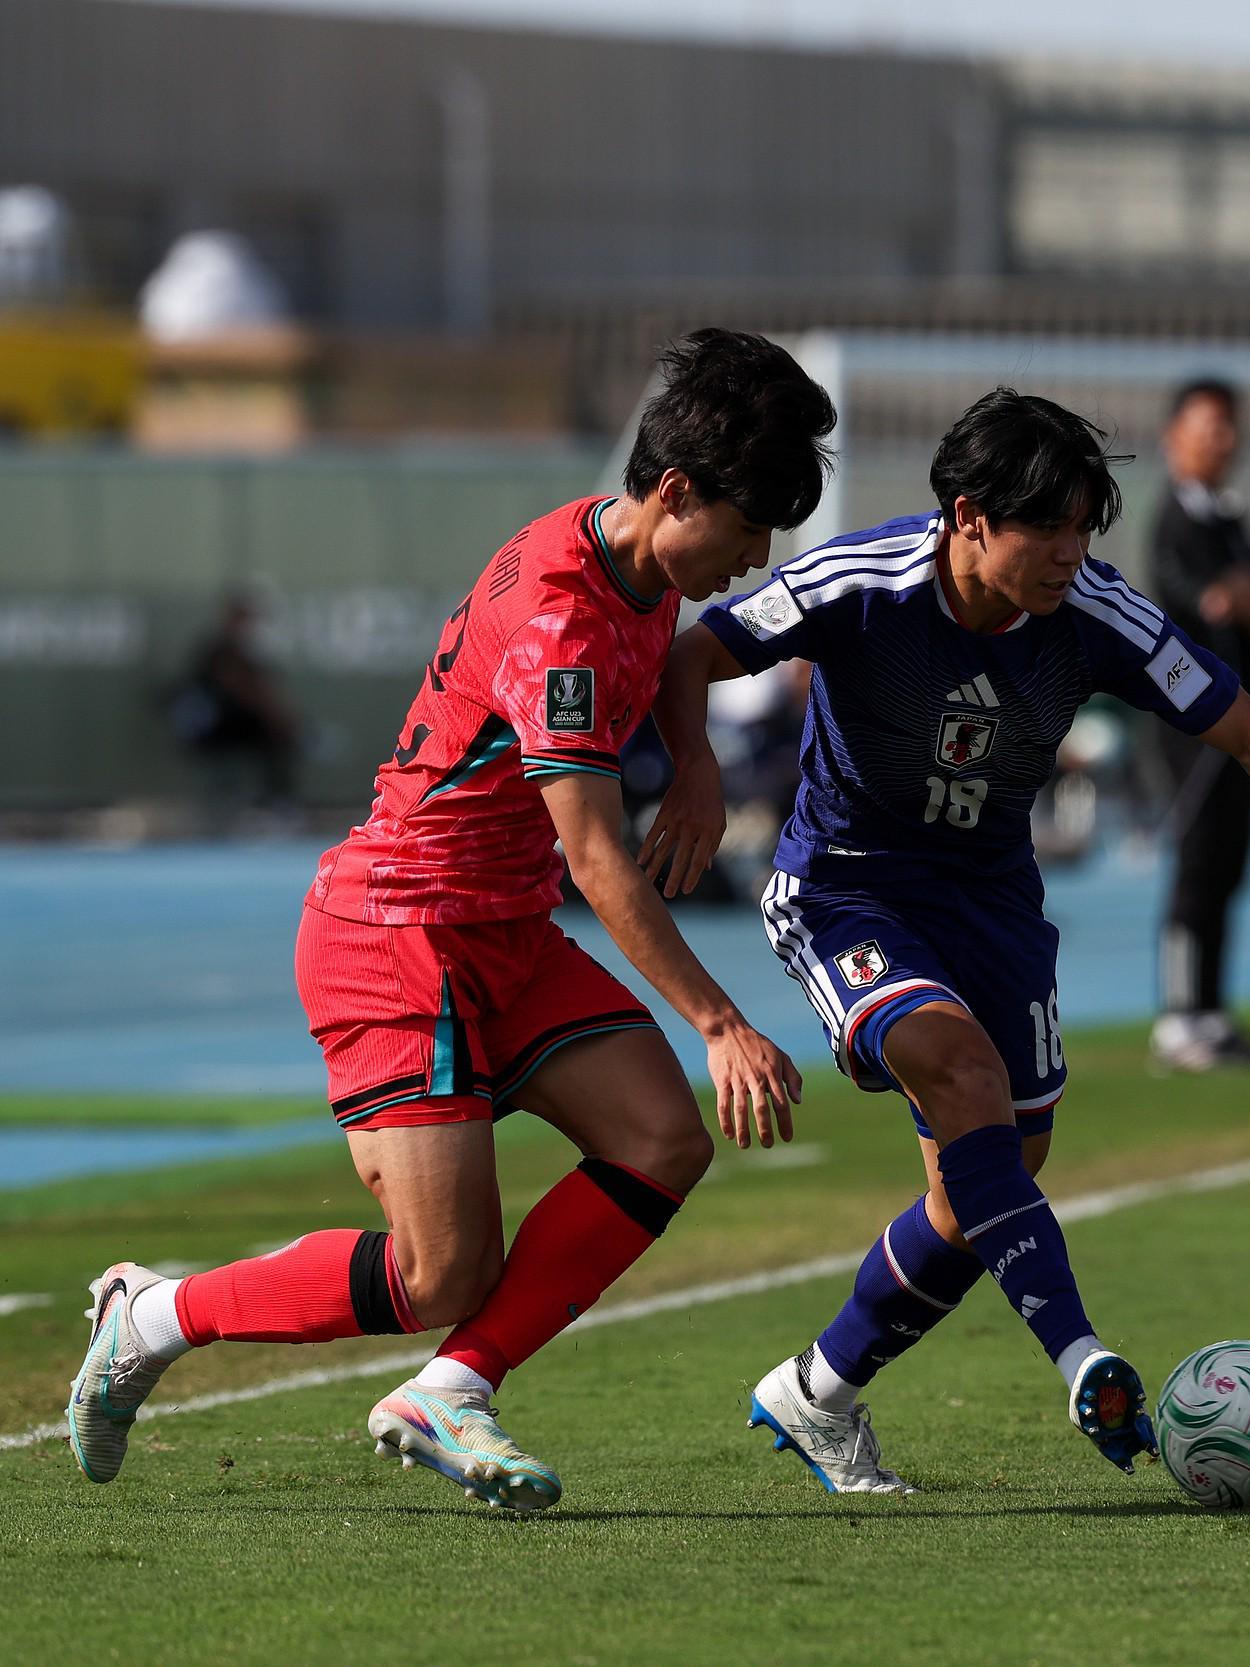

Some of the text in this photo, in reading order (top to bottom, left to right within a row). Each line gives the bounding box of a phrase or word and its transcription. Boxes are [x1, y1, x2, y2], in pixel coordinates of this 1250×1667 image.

[1166, 656, 1191, 690] AFC
[955, 715, 985, 724] JAPAN
[924, 776, 988, 829] 18
[993, 1235, 1038, 1284] APAN
[890, 1322, 922, 1338] JA
